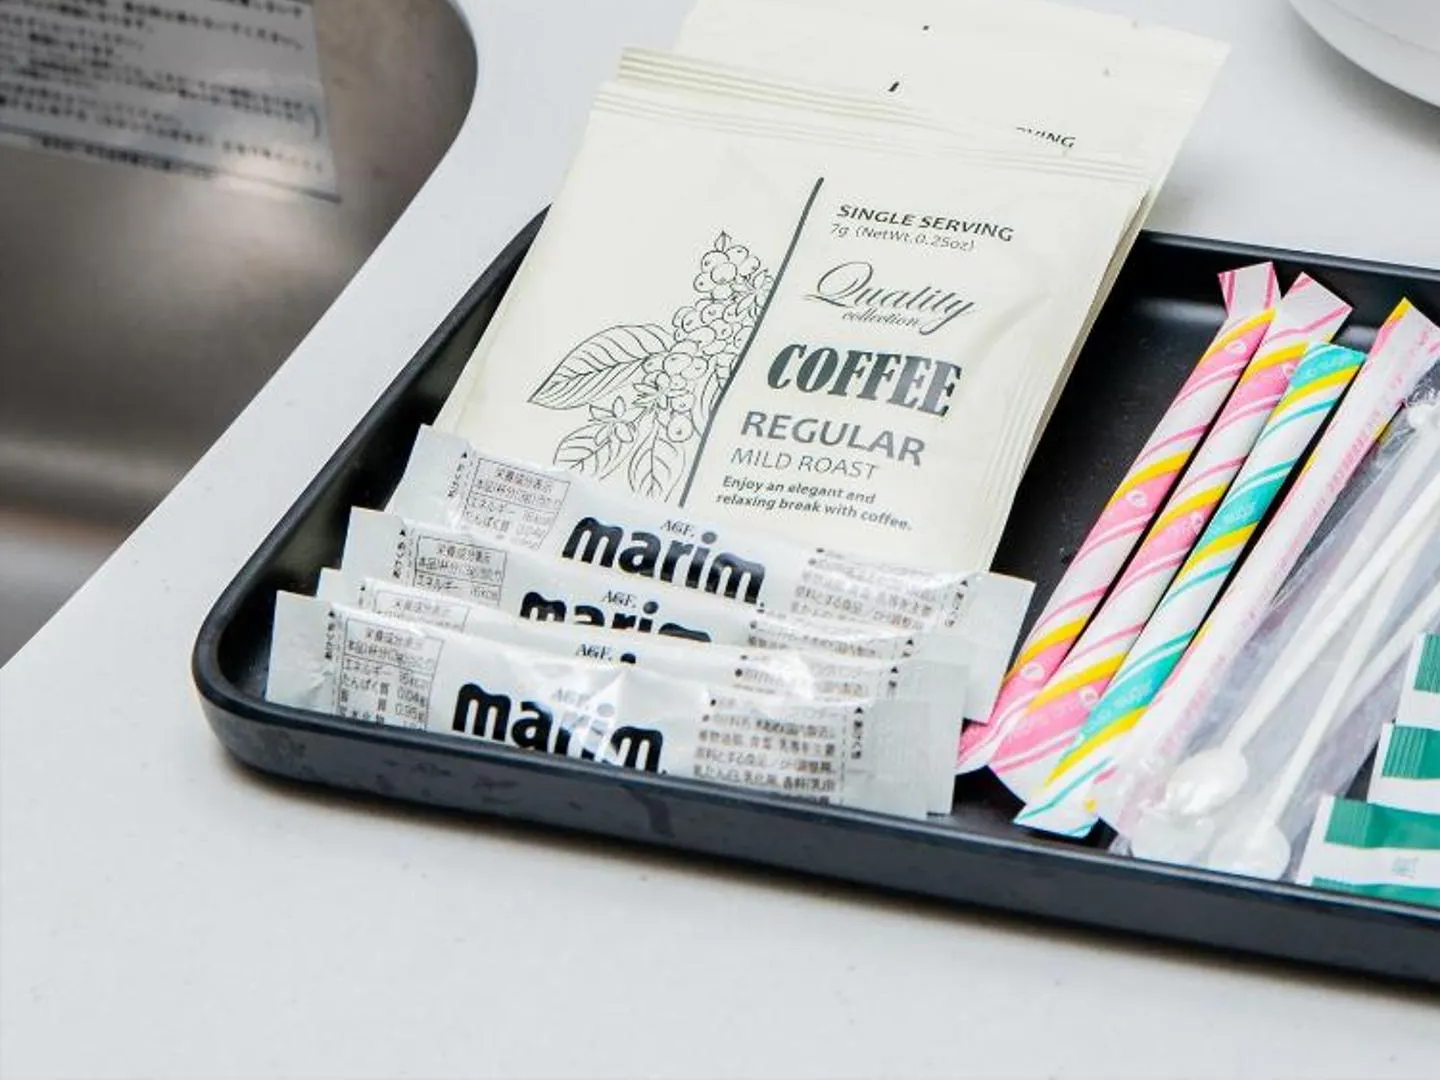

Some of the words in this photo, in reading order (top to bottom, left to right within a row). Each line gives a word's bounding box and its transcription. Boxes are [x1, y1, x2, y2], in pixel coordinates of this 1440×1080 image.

[830, 223, 849, 238] 7g
[836, 204, 916, 226] SINGLE
[918, 216, 1014, 242] SERVING
[803, 261, 976, 336] Quality
[842, 308, 918, 328] collection
[767, 343, 962, 418] COFFEE
[740, 410, 925, 467] REGULAR
[730, 447, 792, 470] MILD
[797, 455, 879, 480] ROAST
[722, 475, 763, 493] Enjoy
[766, 481, 784, 493] an
[788, 481, 844, 501] elegant
[846, 491, 876, 505] and
[715, 493, 776, 511] relaxing
[778, 498, 821, 513] break
[825, 503, 857, 518] with
[861, 510, 913, 532] coffee.
[561, 516, 765, 604] marim
